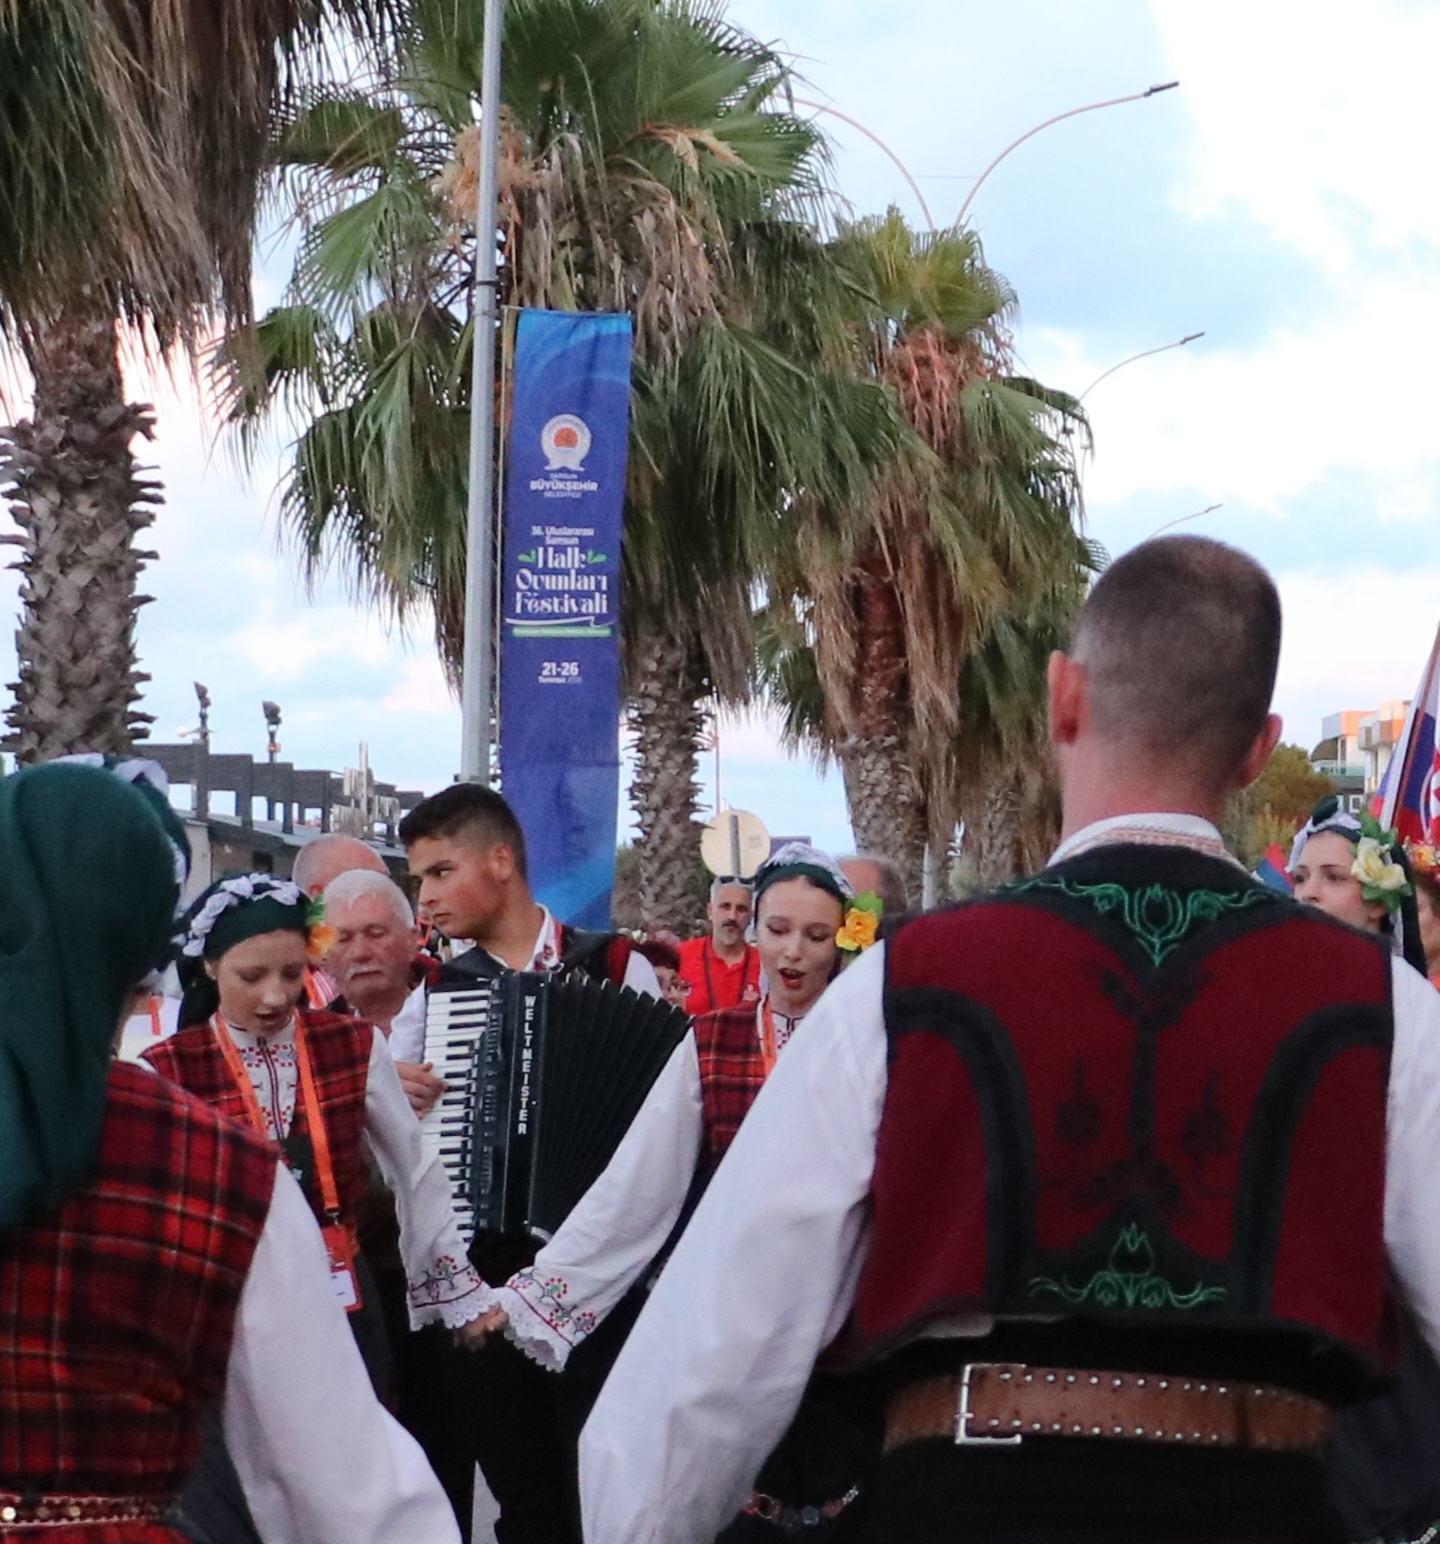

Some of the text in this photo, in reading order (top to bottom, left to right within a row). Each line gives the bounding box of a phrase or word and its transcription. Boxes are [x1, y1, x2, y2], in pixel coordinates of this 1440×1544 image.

[530, 478, 599, 491] BÜYÜKŞEHİR
[537, 546, 587, 569] Halk
[515, 568, 608, 591] Oyunları
[515, 591, 608, 614] Festivali
[541, 661, 580, 676] 21-26
[517, 995, 536, 1135] WELTMEISTER
